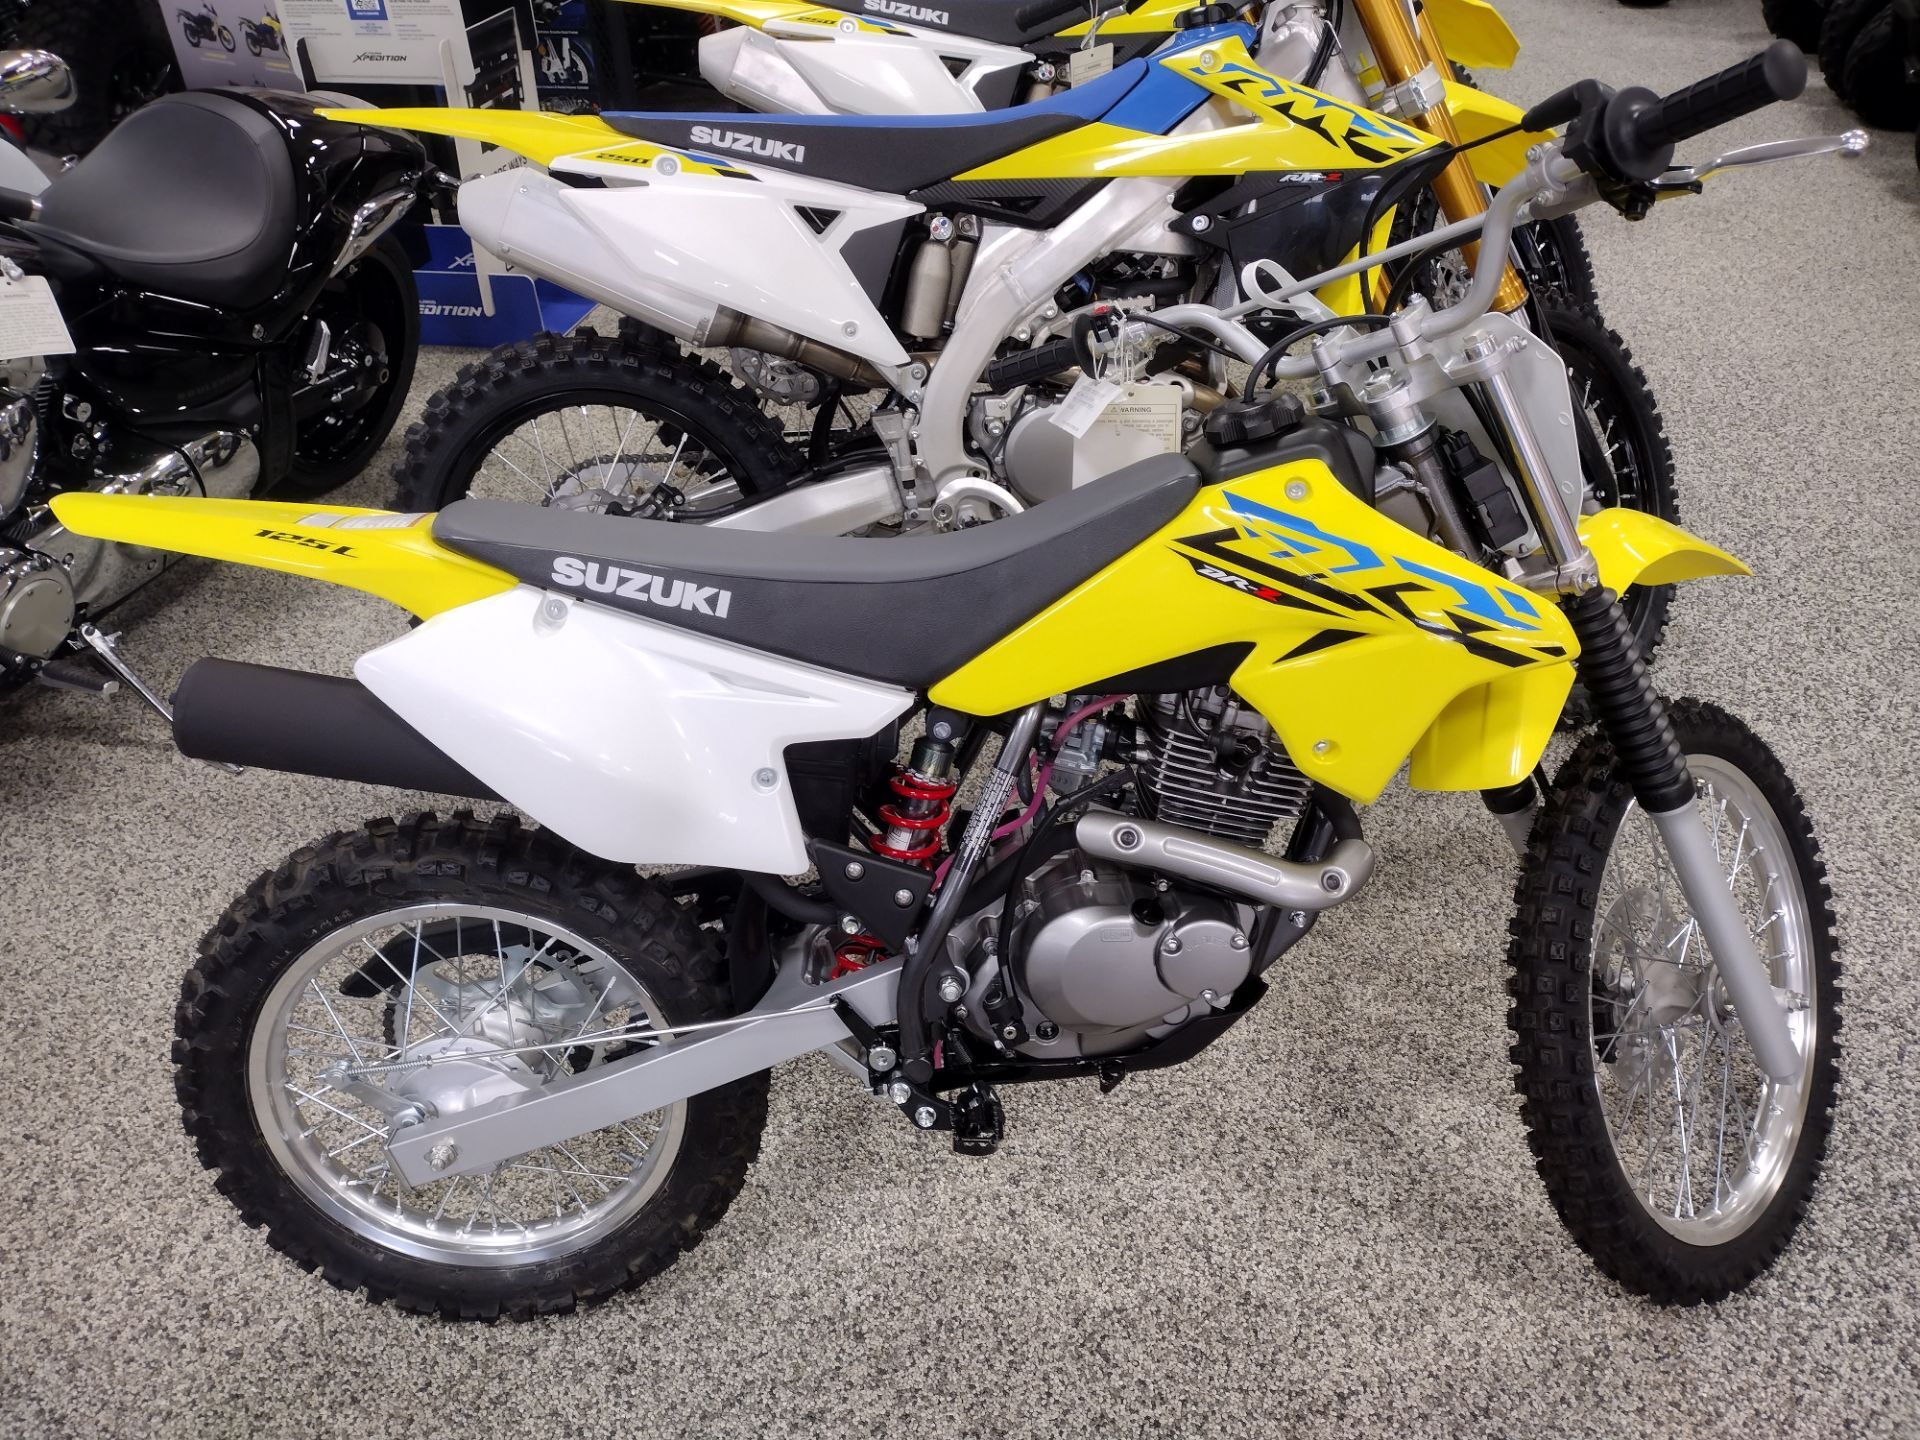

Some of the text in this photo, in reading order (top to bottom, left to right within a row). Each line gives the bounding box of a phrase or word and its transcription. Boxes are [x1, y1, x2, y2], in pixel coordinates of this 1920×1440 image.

[864, 0, 950, 25] SUZUKI
[352, 51, 407, 64] XPEDITION
[690, 125, 806, 163] SUZUKI
[596, 152, 652, 165] 250
[419, 304, 483, 317] EDITION
[254, 528, 359, 559] 125L
[551, 556, 732, 619] SUZUKI
[1196, 563, 1283, 603] DR-Z
